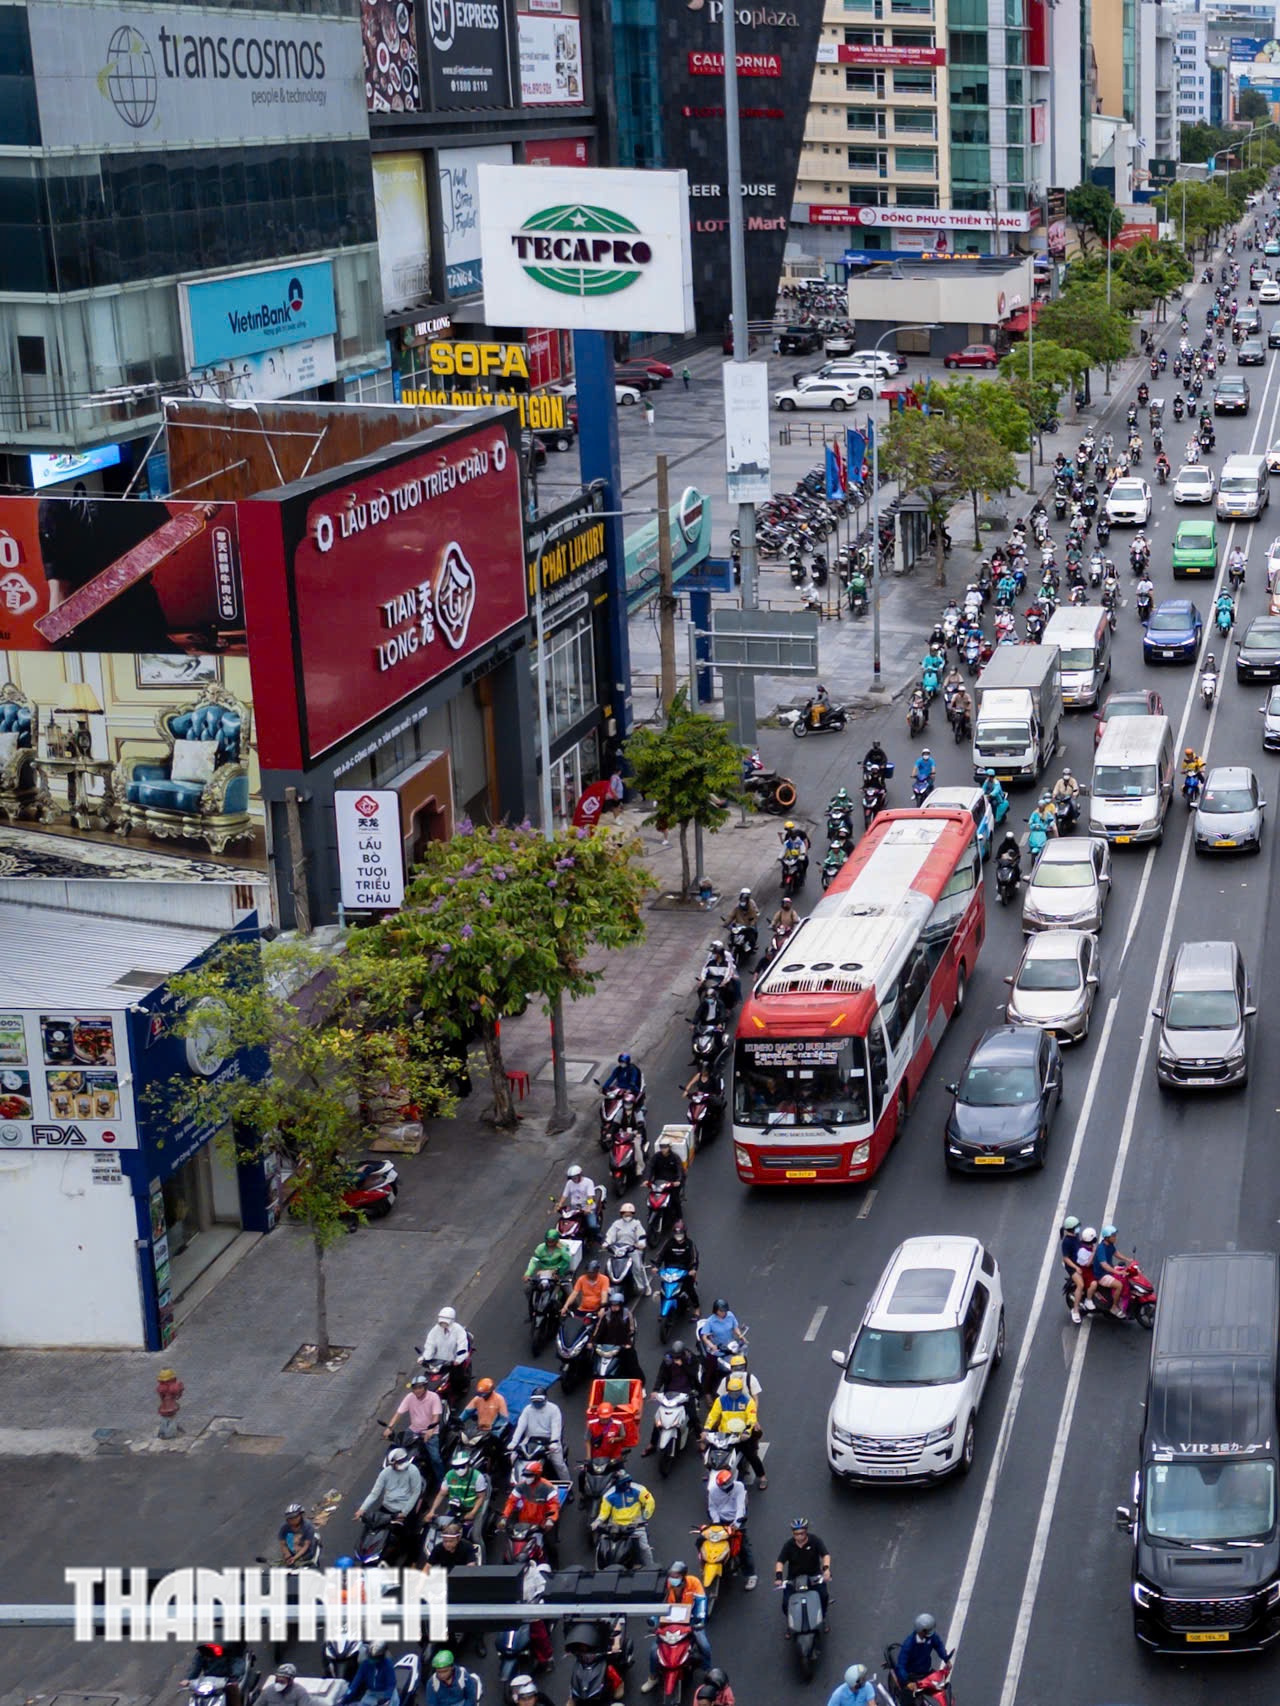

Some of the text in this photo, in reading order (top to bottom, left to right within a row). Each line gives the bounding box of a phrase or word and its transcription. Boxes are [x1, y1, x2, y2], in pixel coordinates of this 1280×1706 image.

[456, 2, 499, 29] EXPRESS
[159, 26, 325, 79] transcosmos
[693, 54, 777, 68] CALIORNIA
[251, 88, 327, 105] people & technology
[748, 216, 786, 231] Mart
[917, 215, 946, 226] PHỤC
[950, 213, 981, 225] THIÊN
[984, 217, 1022, 227] TRANG
[511, 236, 652, 264] TECAPRO
[228, 301, 291, 334] VietinBank
[430, 343, 529, 378] SOFA
[529, 389, 564, 428] GÒN
[370, 488, 389, 525] BÒ
[542, 541, 567, 588] PHÁT
[569, 522, 604, 572] LUXURY
[384, 589, 417, 628] TIAN
[378, 630, 418, 672] LONG
[362, 851, 380, 863] BÒ
[356, 877, 390, 890] TRIỀU
[357, 892, 391, 903] CHÂU
[31, 1125, 87, 1145] FDA
[1180, 1443, 1209, 1452] VIP
